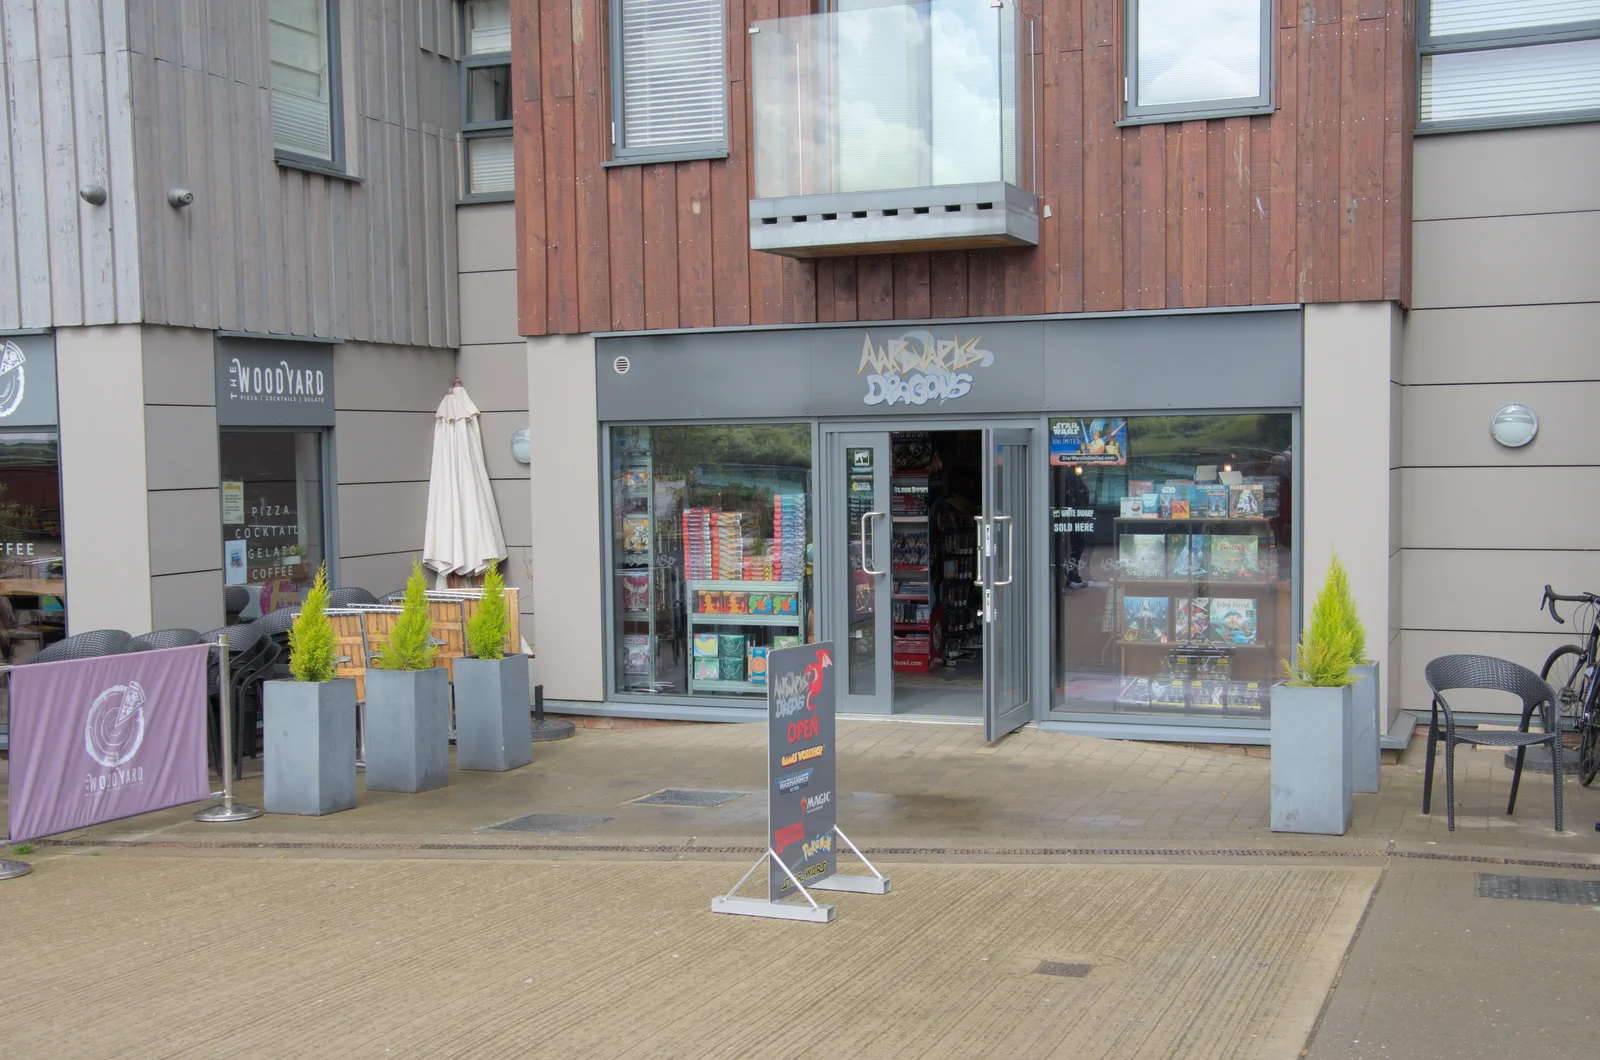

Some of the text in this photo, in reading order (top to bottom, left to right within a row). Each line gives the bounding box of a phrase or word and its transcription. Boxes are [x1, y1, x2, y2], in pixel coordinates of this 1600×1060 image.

[857, 330, 988, 376] AARDVARKS
[229, 366, 238, 400] THE
[232, 357, 324, 396] WOODYARD
[863, 372, 974, 407] DRAGONS
[1053, 428, 1080, 436] WARS
[251, 504, 290, 517] PIZZA
[235, 524, 307, 539] COCKTAILS
[1053, 523, 1094, 532] SOLD HERE
[248, 545, 297, 560] GELATO
[252, 565, 294, 580] COFFEE
[787, 717, 819, 743] OPEN
[781, 745, 823, 767] GAMES WORKSHOP
[806, 791, 831, 809] MAGIC
[804, 860, 828, 879] WARS
